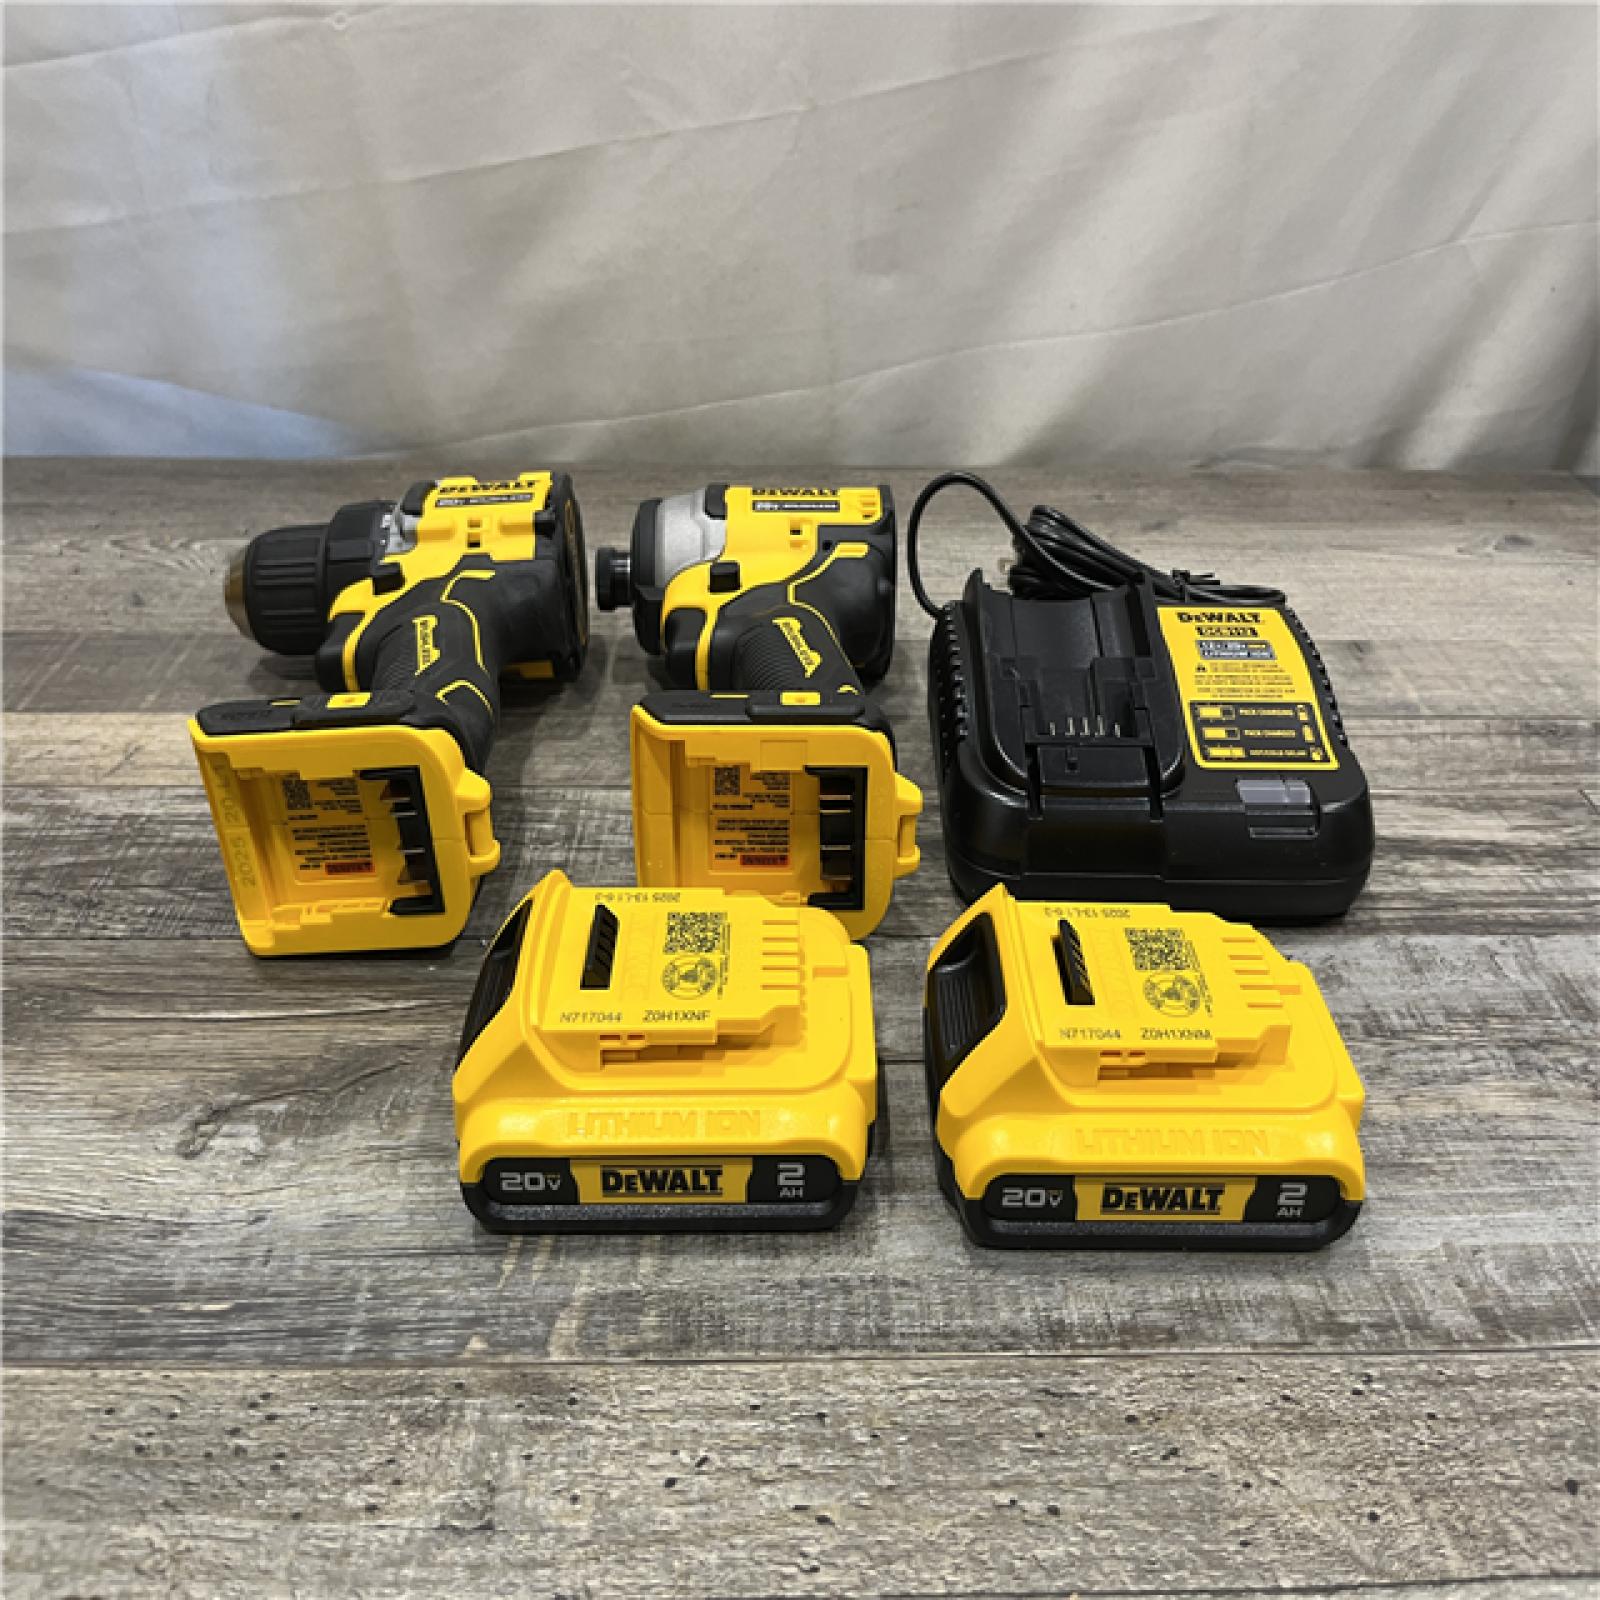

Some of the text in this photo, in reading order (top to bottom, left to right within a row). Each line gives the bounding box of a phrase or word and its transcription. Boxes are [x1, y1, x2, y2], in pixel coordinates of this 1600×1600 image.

[568, 1110, 761, 1138] LITHIUM ION
[1074, 1129, 1271, 1156] LITHIUM ION
[777, 1163, 805, 1186] 2
[779, 1187, 804, 1198] AH
[1277, 1183, 1307, 1206] 2
[1277, 1207, 1304, 1217] AH
